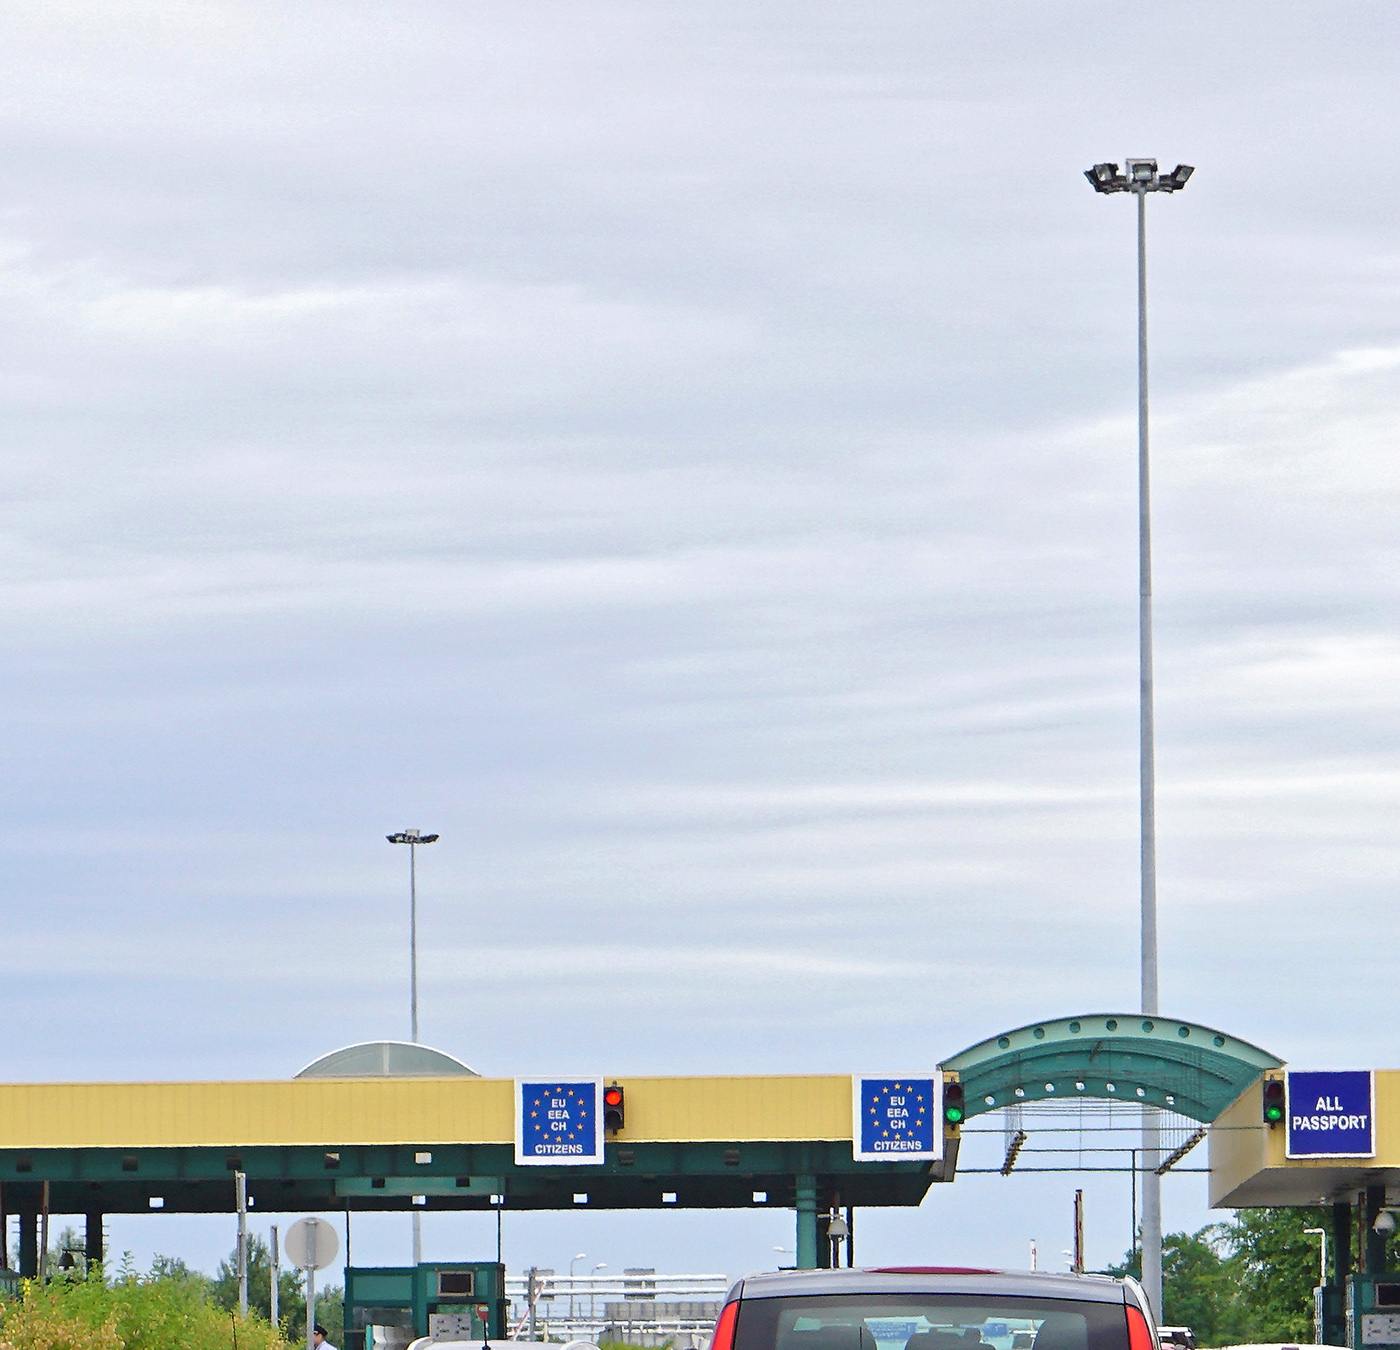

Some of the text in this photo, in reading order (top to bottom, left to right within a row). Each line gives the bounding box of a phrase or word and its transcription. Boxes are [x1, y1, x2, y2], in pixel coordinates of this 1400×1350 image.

[551, 1098, 566, 1108] EU
[890, 1096, 905, 1106] EU
[1315, 1096, 1344, 1111] ALL
[547, 1109, 570, 1120] EEA
[886, 1108, 909, 1118] EEA
[550, 1121, 567, 1131] CH
[889, 1120, 906, 1129] CH
[1292, 1115, 1367, 1130] PASSPORT
[534, 1144, 583, 1154] CITIZENS
[873, 1140, 922, 1151] CITIZENS
